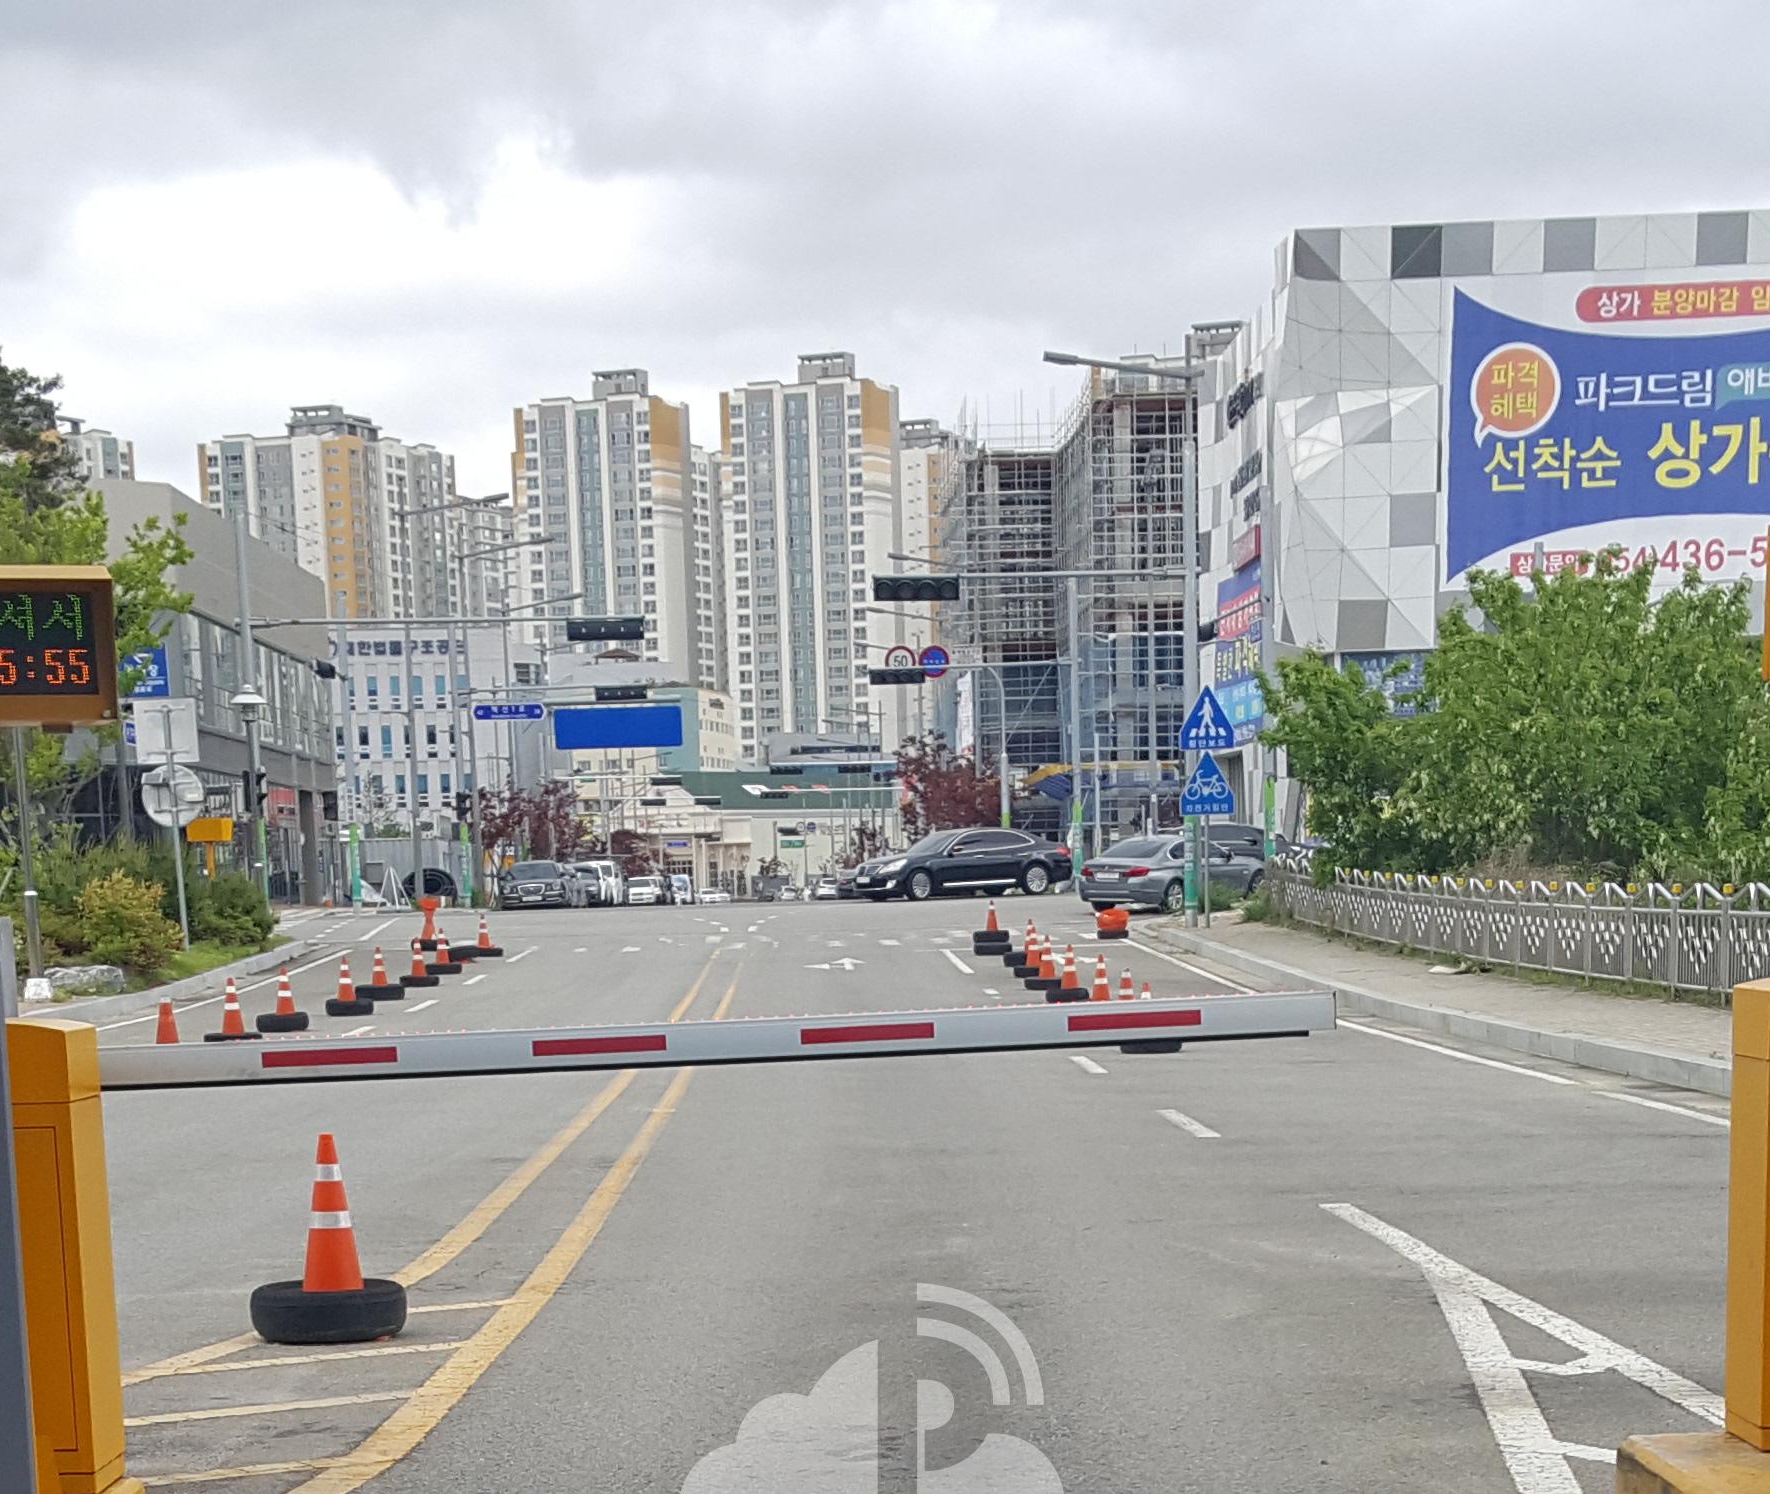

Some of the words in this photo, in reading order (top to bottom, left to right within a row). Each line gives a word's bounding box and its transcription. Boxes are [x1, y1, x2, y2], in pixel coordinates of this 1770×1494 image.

[1597, 290, 1641, 318] 상가
[1651, 288, 1741, 316] 분양마감
[1490, 360, 1540, 388] 파격
[1490, 390, 1538, 419] 혜택
[1574, 368, 1713, 412] 파크드림
[1483, 437, 1622, 493] 선착순
[893, 655, 908, 668] 50
